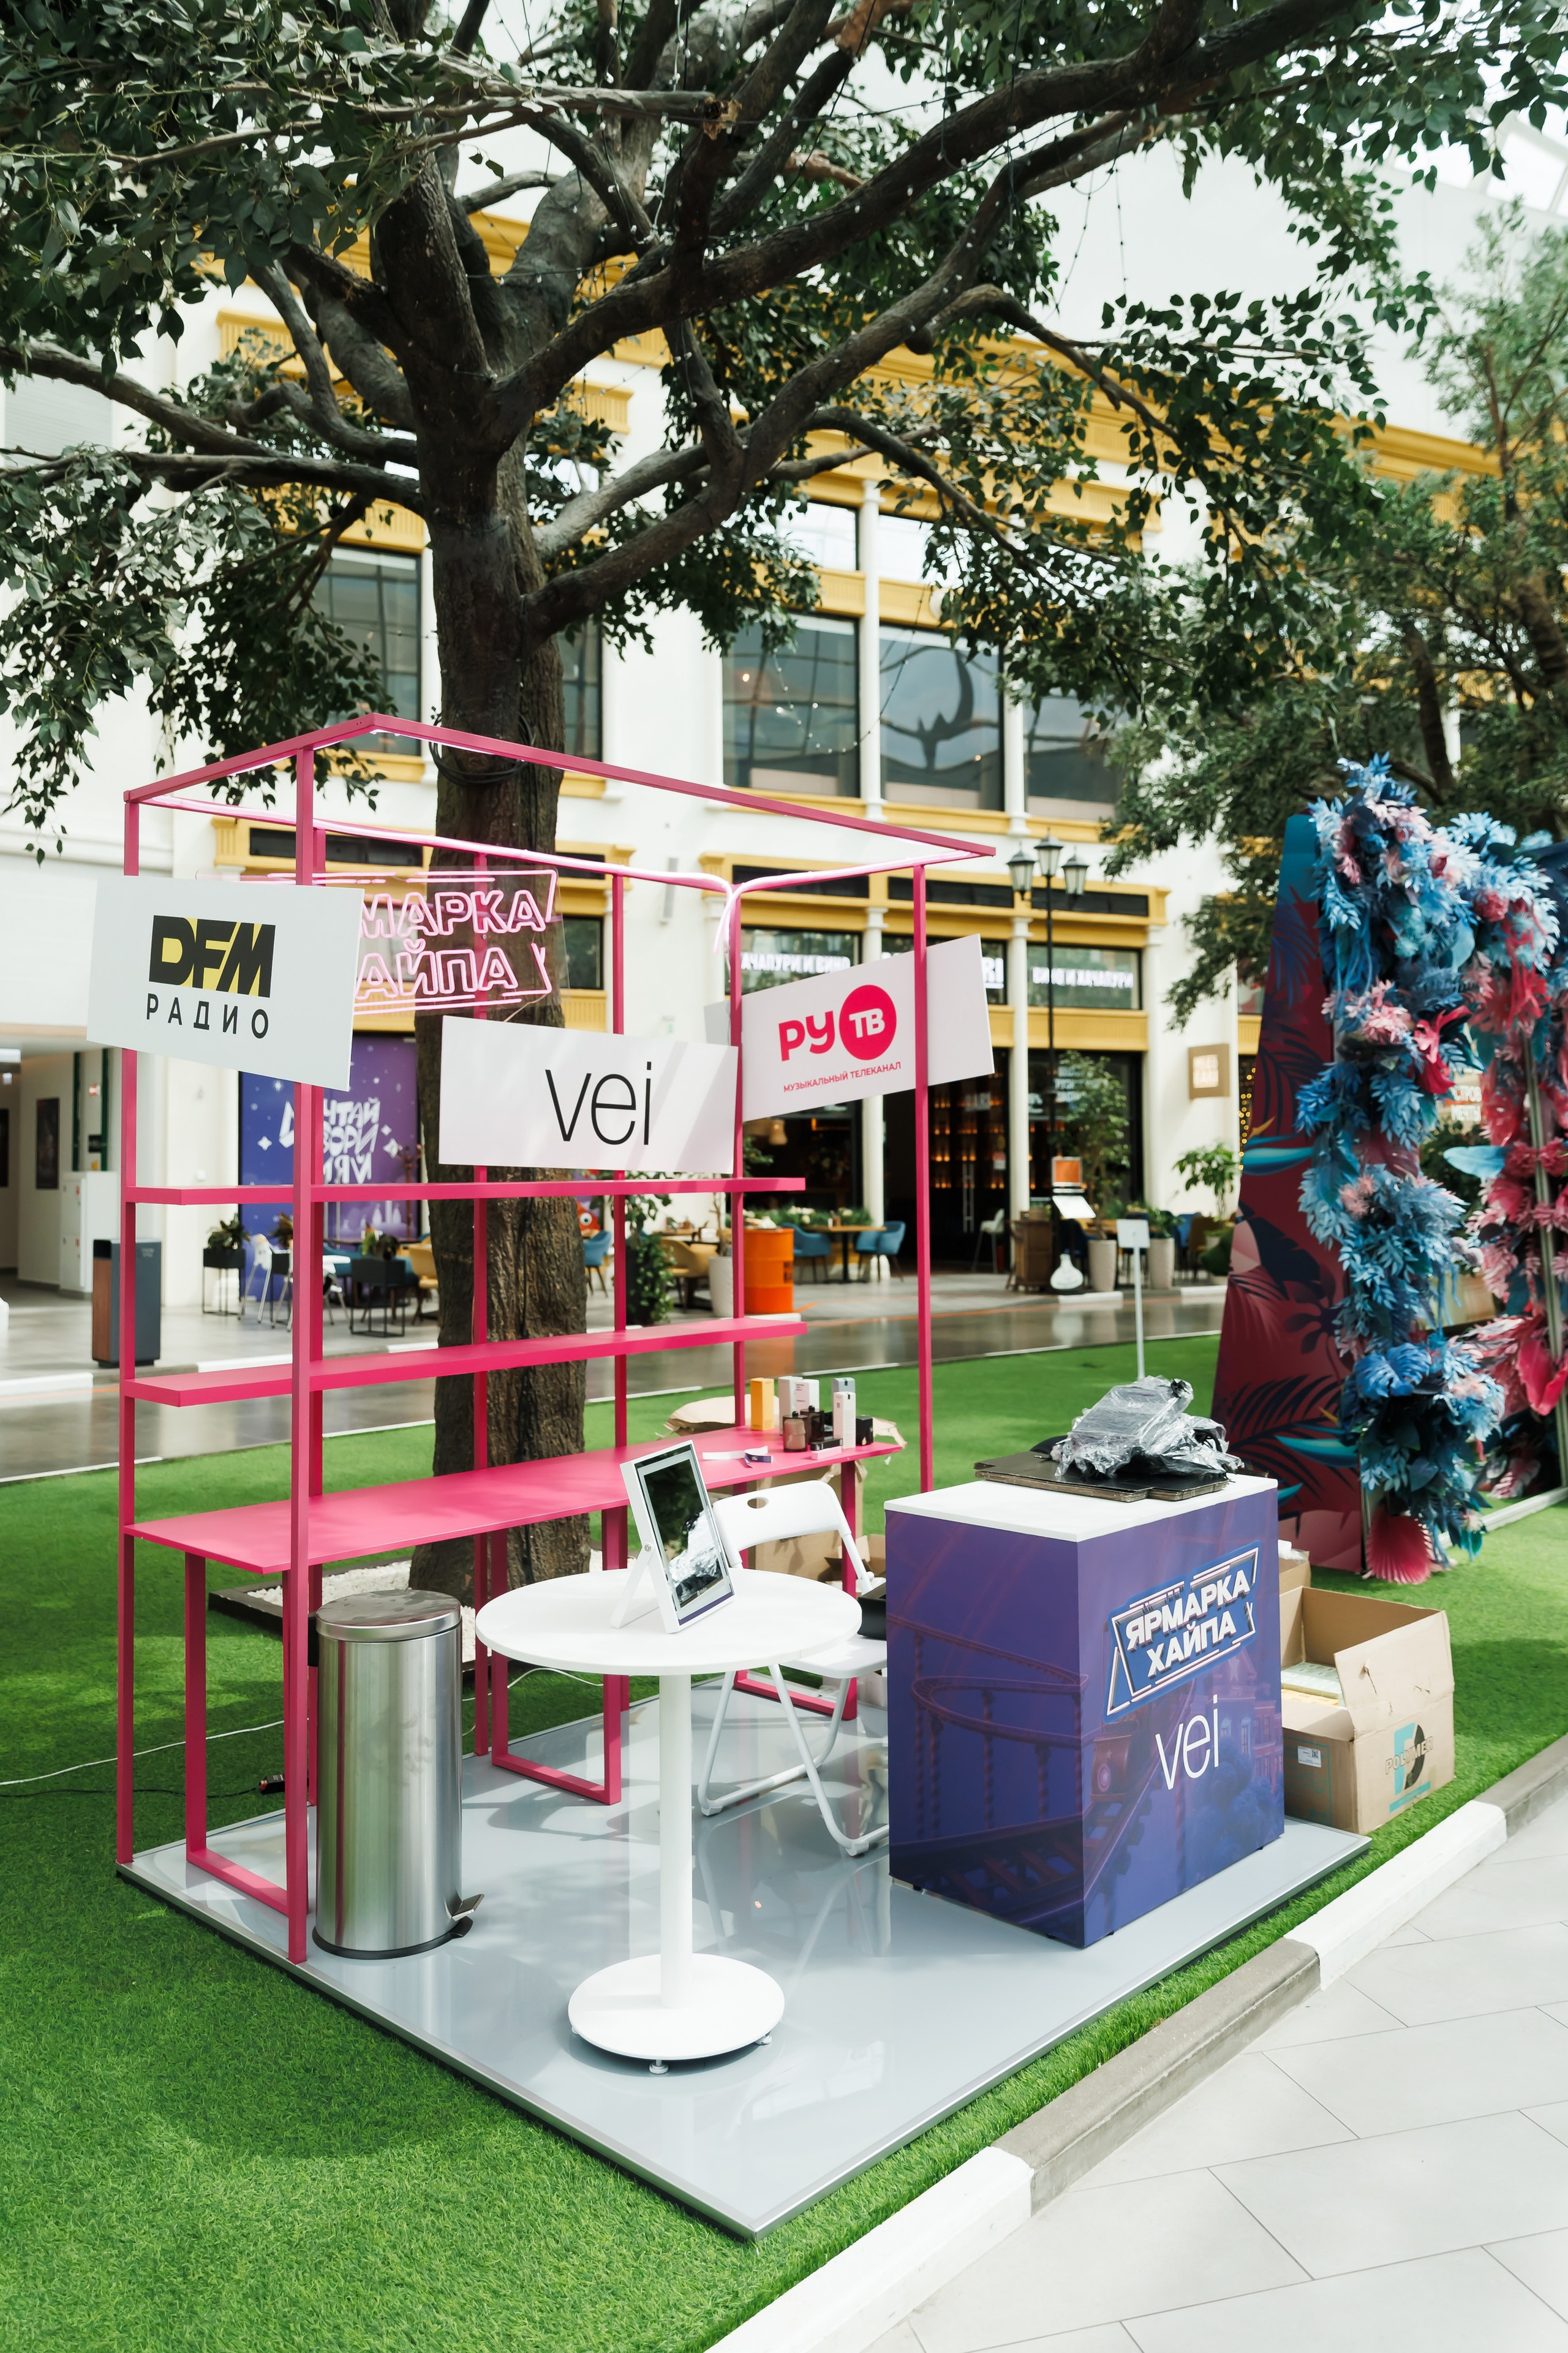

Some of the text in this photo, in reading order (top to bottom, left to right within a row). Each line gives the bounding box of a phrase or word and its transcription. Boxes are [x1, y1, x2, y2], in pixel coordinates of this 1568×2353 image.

[360, 889, 546, 939] МАРКА
[149, 915, 276, 998] DFM
[355, 939, 519, 1000] АЙПА
[741, 952, 802, 973] АЧАПУРИ
[146, 993, 268, 1039] РАДИО
[545, 1062, 652, 1145] vei
[783, 1062, 901, 1092] МУЗЫКАЛЬНЫЙ ТЕЛЕКАНАЛ
[323, 1120, 379, 1157] ВОРИ
[1126, 1569, 1251, 1652] ЯРМАРКА
[1146, 1611, 1237, 1679] ХАЙПА
[1155, 1694, 1219, 1790] vei
[1385, 1735, 1433, 1775] POLYMER
